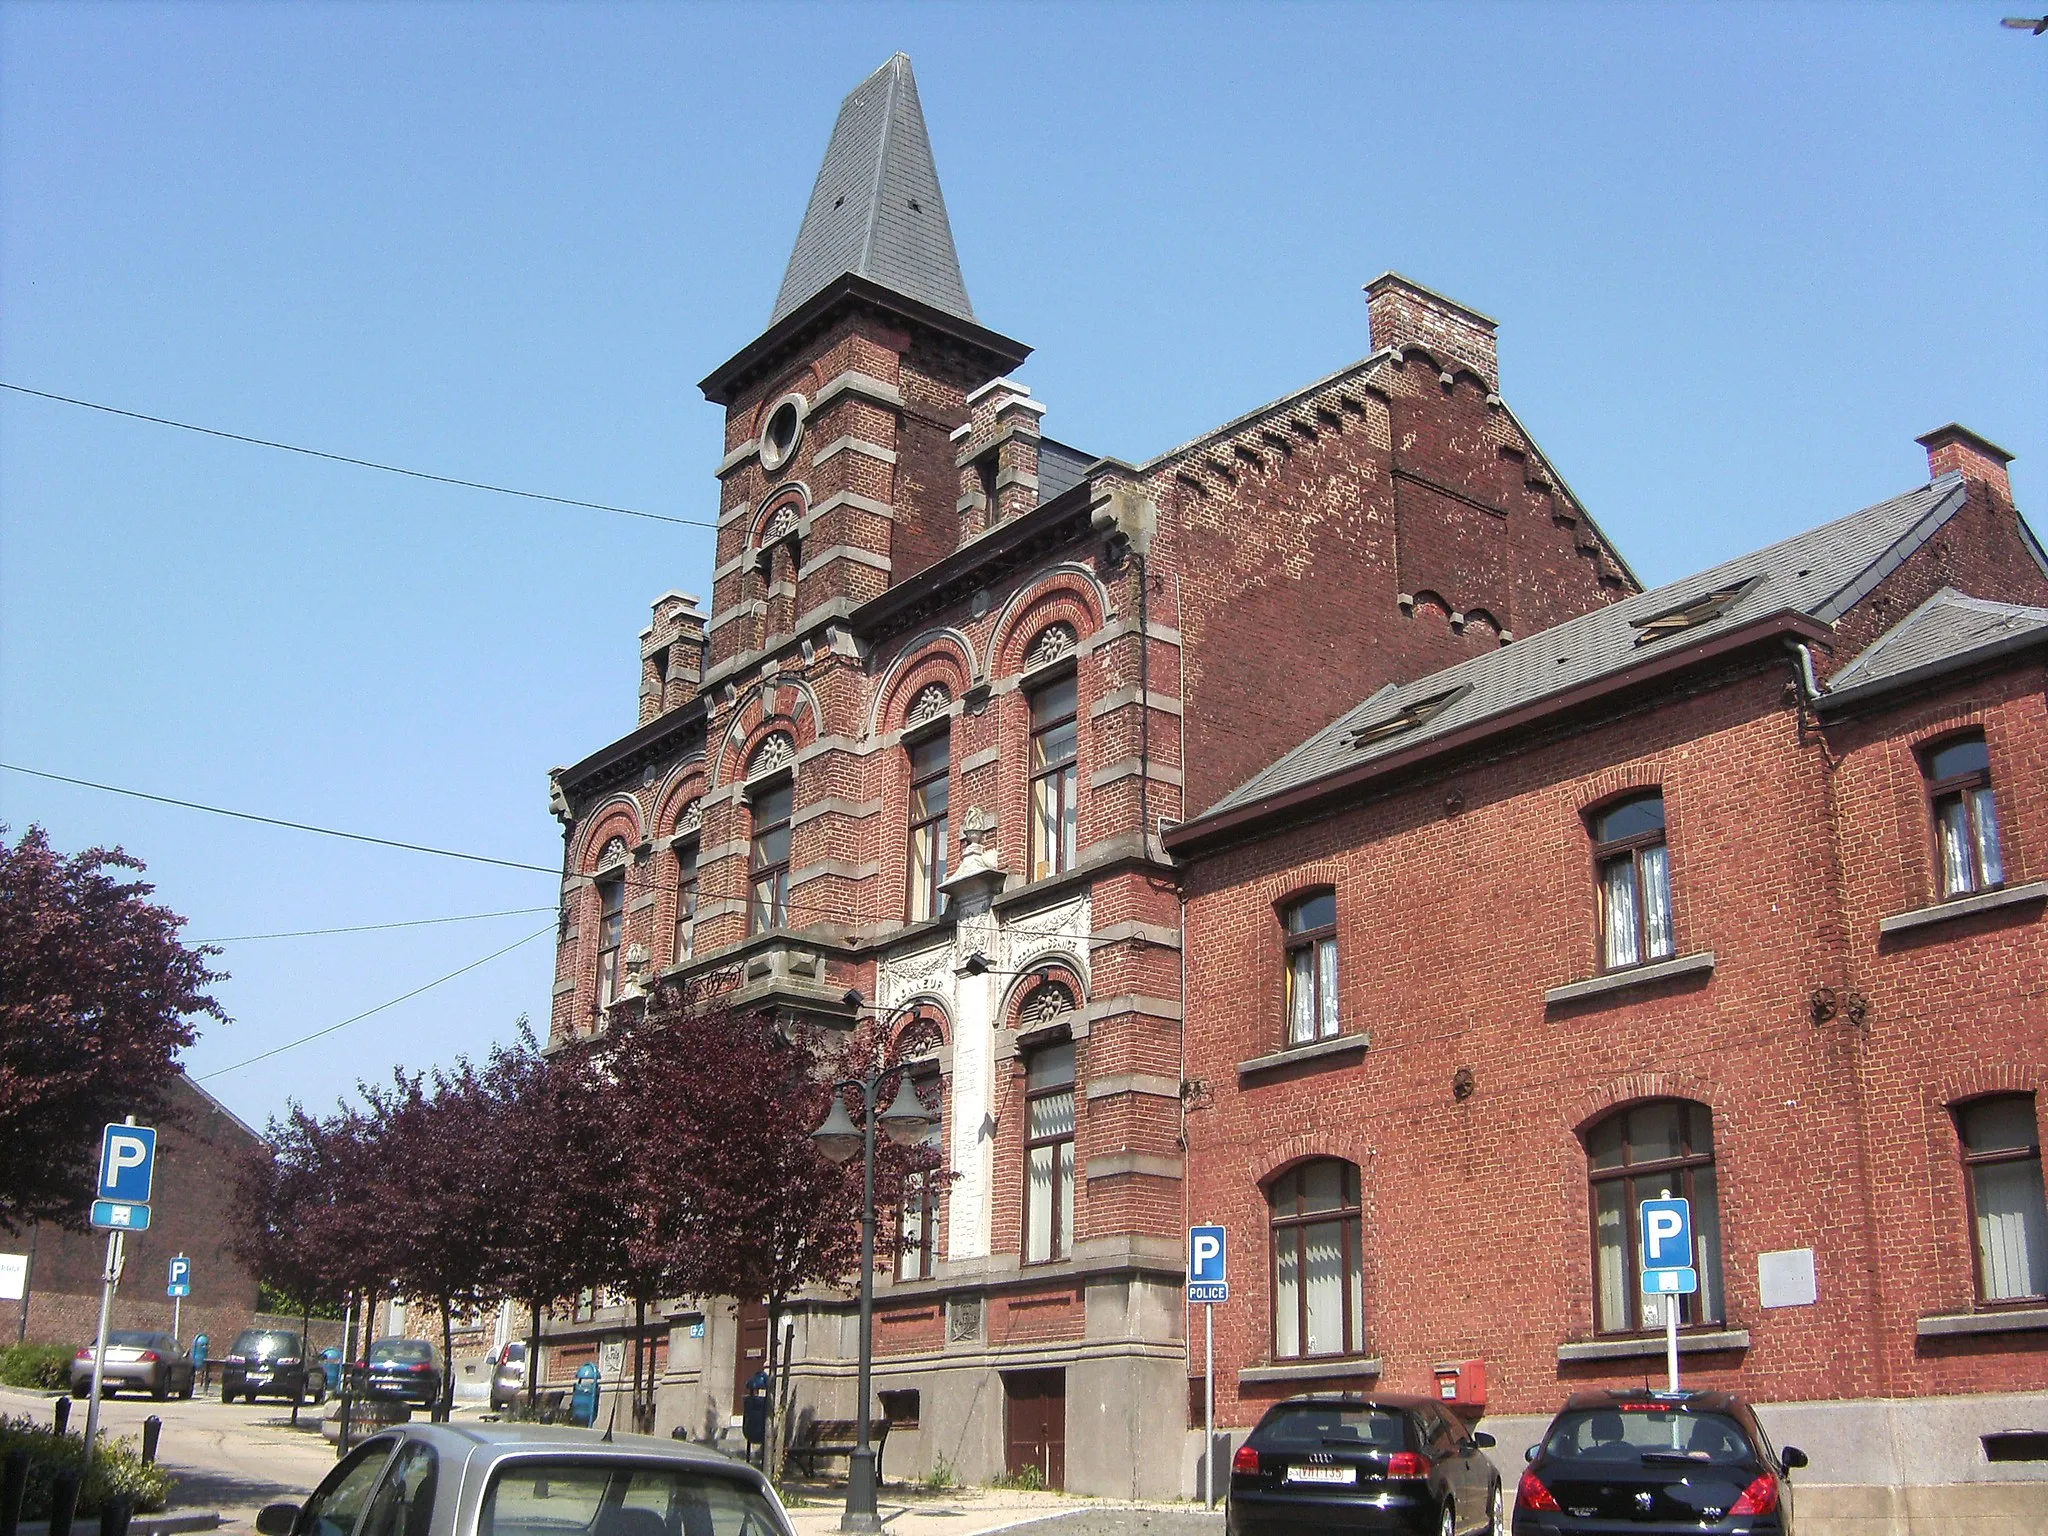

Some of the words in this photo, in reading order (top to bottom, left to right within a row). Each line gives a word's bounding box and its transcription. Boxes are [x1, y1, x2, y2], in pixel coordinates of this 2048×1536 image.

[106, 1135, 147, 1188] P
[1647, 1209, 1683, 1259] P
[172, 1261, 187, 1282] P
[1194, 1236, 1220, 1275] P
[1189, 1287, 1225, 1299] POLICE
